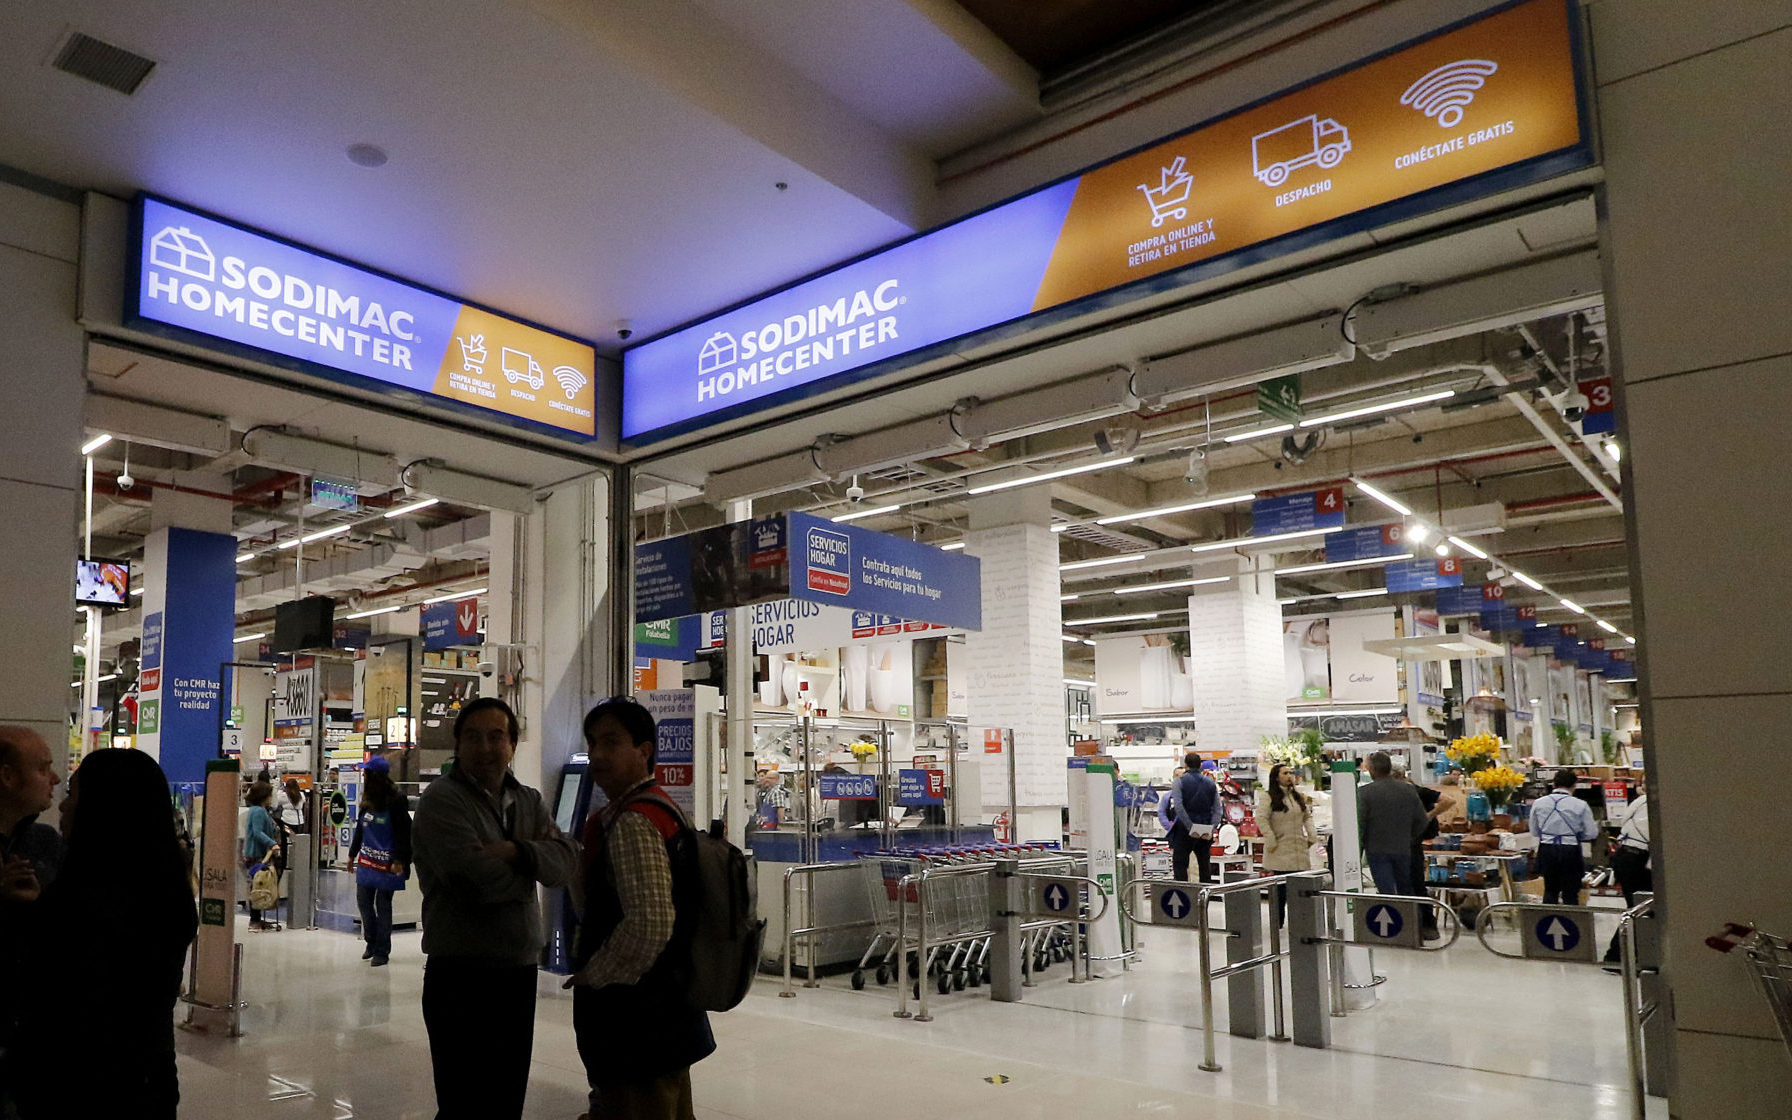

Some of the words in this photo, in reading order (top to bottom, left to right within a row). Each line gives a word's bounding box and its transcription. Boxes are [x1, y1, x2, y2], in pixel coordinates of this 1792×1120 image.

[1395, 138, 1464, 170] CONÉCTATE
[1467, 120, 1516, 146] GRATIS
[1275, 179, 1332, 208] DESPACHO
[1128, 235, 1166, 255] COMPRA
[1168, 221, 1204, 242] ONLINE
[1206, 218, 1213, 229] Y
[1128, 248, 1161, 267] RETIRA
[1164, 243, 1177, 256] EN
[1180, 231, 1216, 251] TIENDA
[222, 256, 415, 342] SODIMAC
[147, 272, 413, 371] HOMECENTER
[741, 279, 898, 361] SODIMAC
[697, 316, 899, 402] HOMECENTER
[449, 372, 471, 384] COMPRA
[469, 385, 477, 393] EN
[477, 388, 496, 399] TIENDA
[510, 388, 536, 401] DESPACHO
[1592, 386, 1611, 406] 3
[574, 407, 591, 418] GRATIS
[1323, 493, 1336, 508] 4
[1389, 527, 1399, 540] 6
[810, 535, 847, 555] SERVICIOS
[810, 549, 835, 567] HOGAR
[862, 557, 890, 573] Contrata
[891, 563, 904, 578] aquí
[905, 566, 922, 580] todos
[1444, 560, 1455, 572] 8
[862, 572, 872, 585] los
[873, 574, 901, 591] Servicios
[902, 583, 915, 595] para
[917, 584, 924, 595] tu
[925, 585, 942, 600] hogar
[1485, 587, 1503, 598] 10
[1520, 607, 1535, 617] 12
[174, 678, 188, 688] Con
[190, 679, 206, 688] CMR
[208, 680, 220, 689] haz
[174, 688, 182, 697] tu
[184, 690, 217, 700] proyecto
[649, 692, 671, 703] Nunca
[1105, 688, 1128, 697] Sabor
[180, 700, 210, 709] realidad
[659, 705, 675, 716] peso
[677, 703, 686, 713] de
[390, 725, 396, 738] 2
[658, 725, 692, 737] PRECIOS
[1329, 721, 1374, 733] AMASAR
[231, 734, 237, 745] 3
[658, 737, 692, 751] BAJOS
[341, 829, 349, 841] 3
